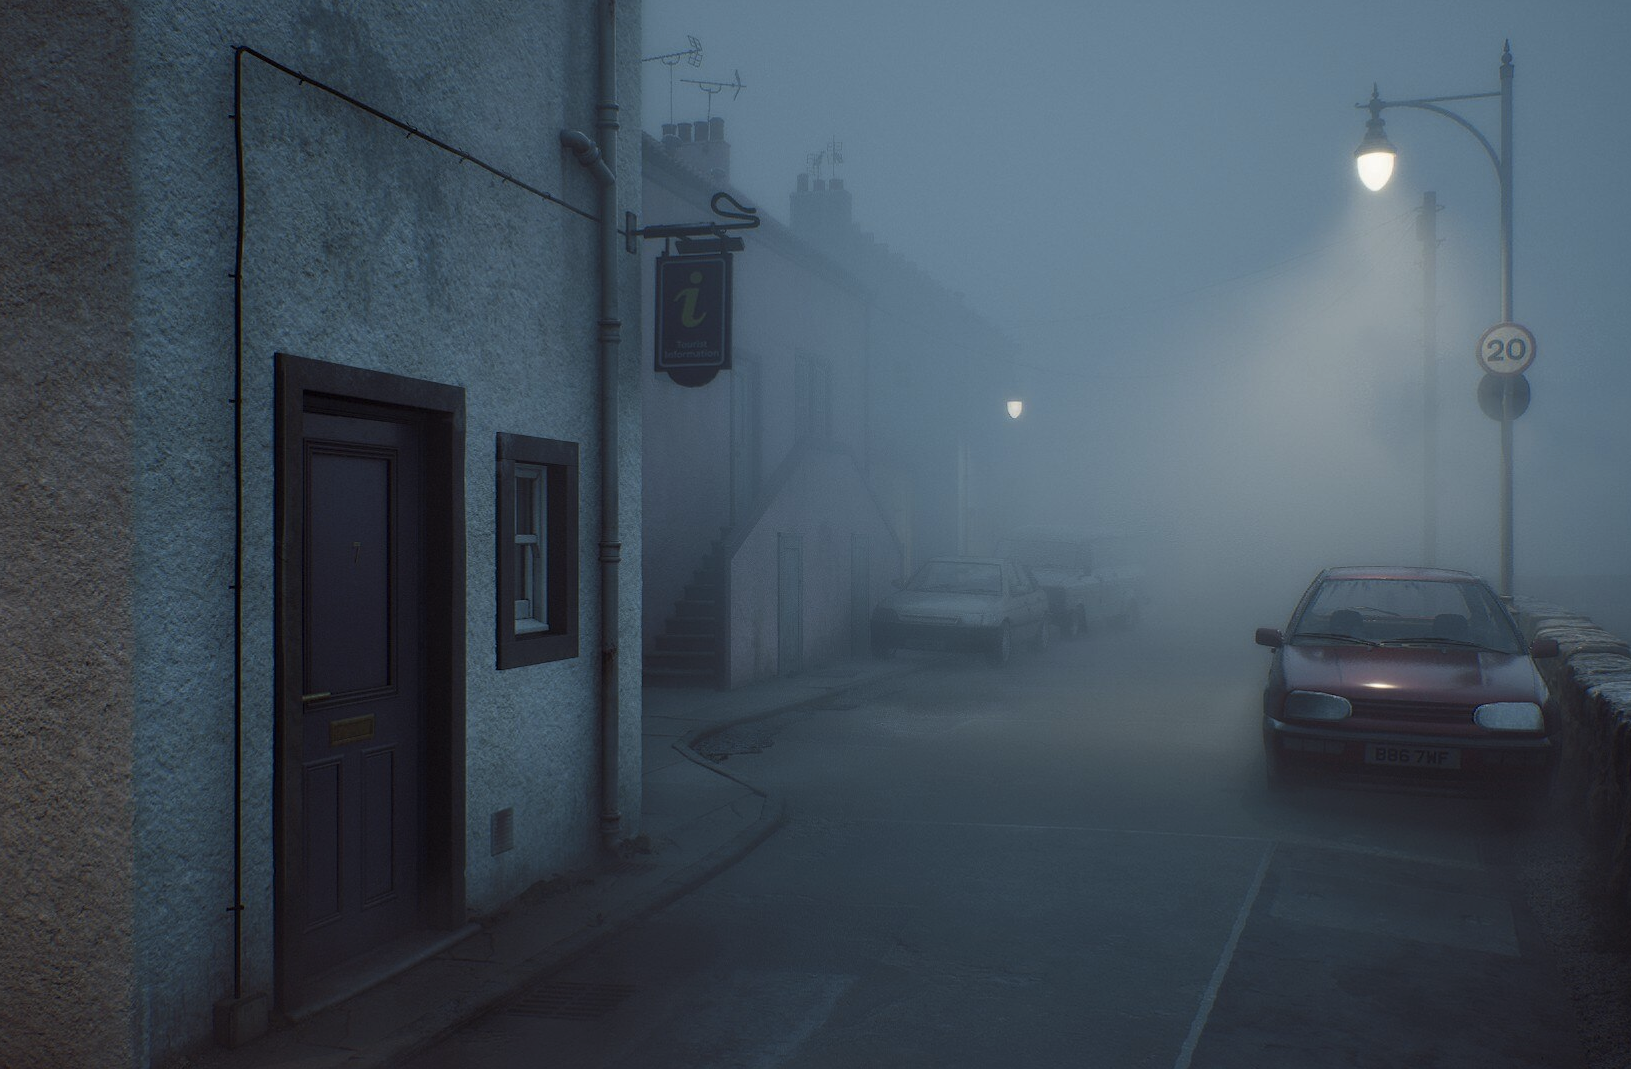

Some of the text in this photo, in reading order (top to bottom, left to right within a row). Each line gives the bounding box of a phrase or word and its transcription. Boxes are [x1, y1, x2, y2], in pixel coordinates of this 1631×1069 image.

[675, 340, 708, 349] Tourist
[1487, 338, 1526, 362] 20
[664, 349, 720, 359] Information
[352, 541, 362, 565] 7
[1414, 750, 1449, 764] 7WF
